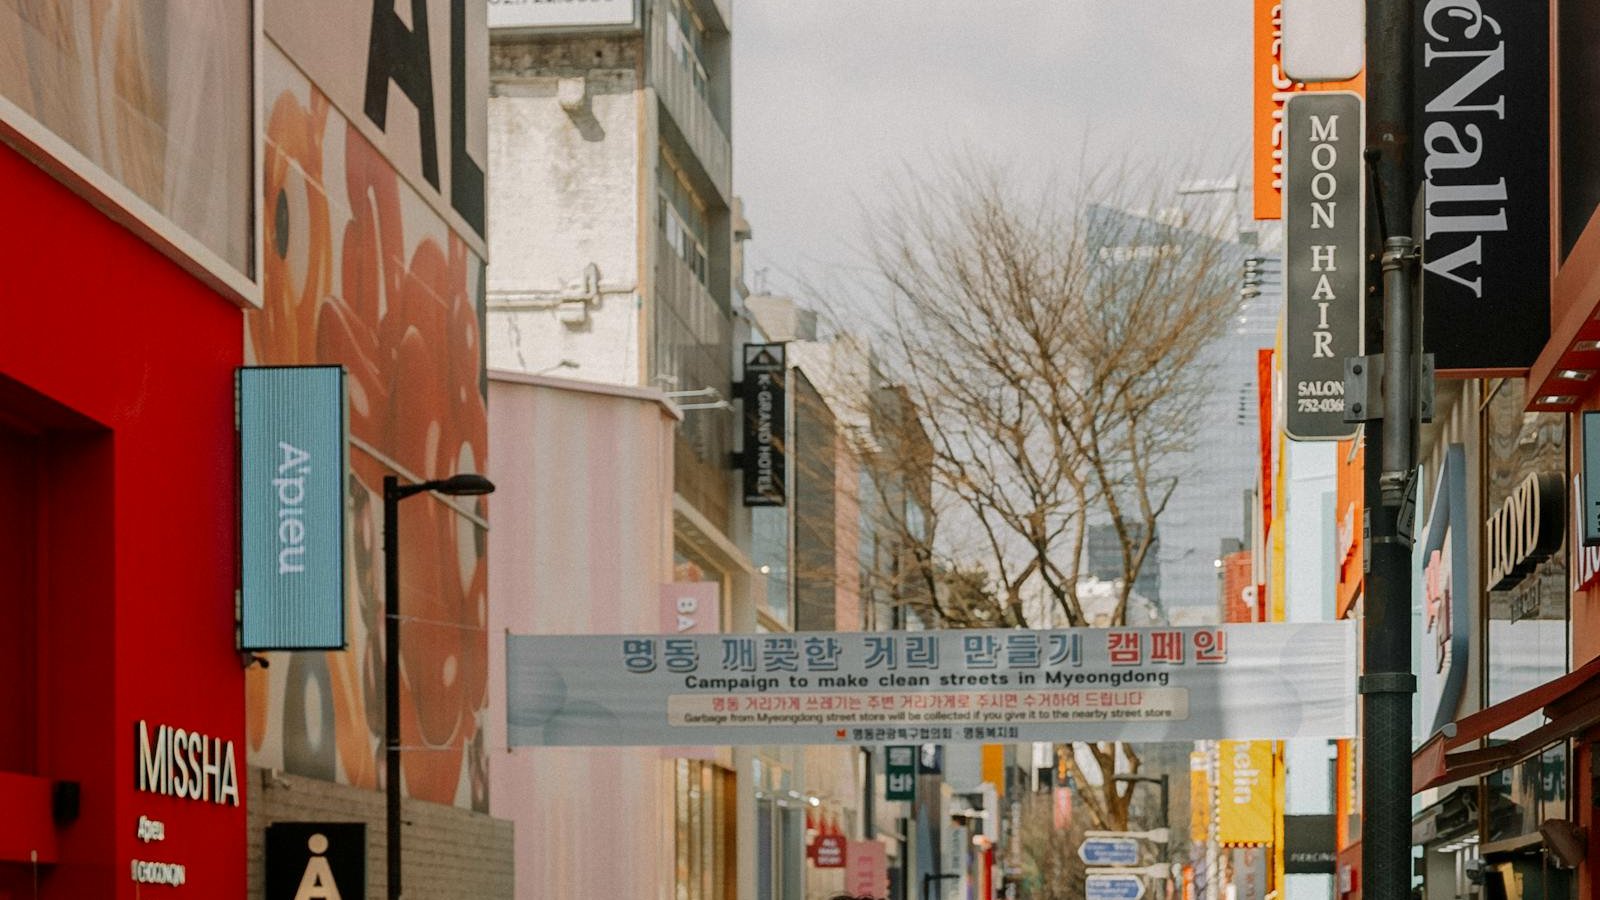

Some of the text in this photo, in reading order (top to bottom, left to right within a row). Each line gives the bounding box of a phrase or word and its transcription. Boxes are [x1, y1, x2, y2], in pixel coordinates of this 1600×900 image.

[1310, 115, 1339, 358] MOON HAIR
[1298, 381, 1344, 396] SALON
[757, 446, 772, 493] HOTEL
[623, 630, 1228, 673] 명동 깨끗한 거리 만들기 캠페인
[685, 669, 1169, 692] Campaign to make clean streets in Myeongdong
[684, 713, 727, 724] Garbage
[730, 713, 754, 722] from
[757, 712, 823, 724] Myeongdong
[826, 711, 856, 721] street
[889, 710, 905, 720] will
[908, 710, 921, 720] be
[924, 710, 970, 720] collected
[973, 710, 981, 719] if
[983, 711, 1002, 721] you
[1004, 710, 1026, 721] give
[1029, 709, 1037, 719] it
[1038, 710, 1049, 719] to
[1052, 709, 1069, 719] the
[1071, 708, 1107, 719] nearby
[1111, 708, 1142, 718] street
[1145, 708, 1172, 717] store
[713, 690, 1143, 711] 명동 거리가게 쓰레기는 주변 거리가게로 주시면 수거하여 드립니다
[138, 719, 239, 807] MISSHA
